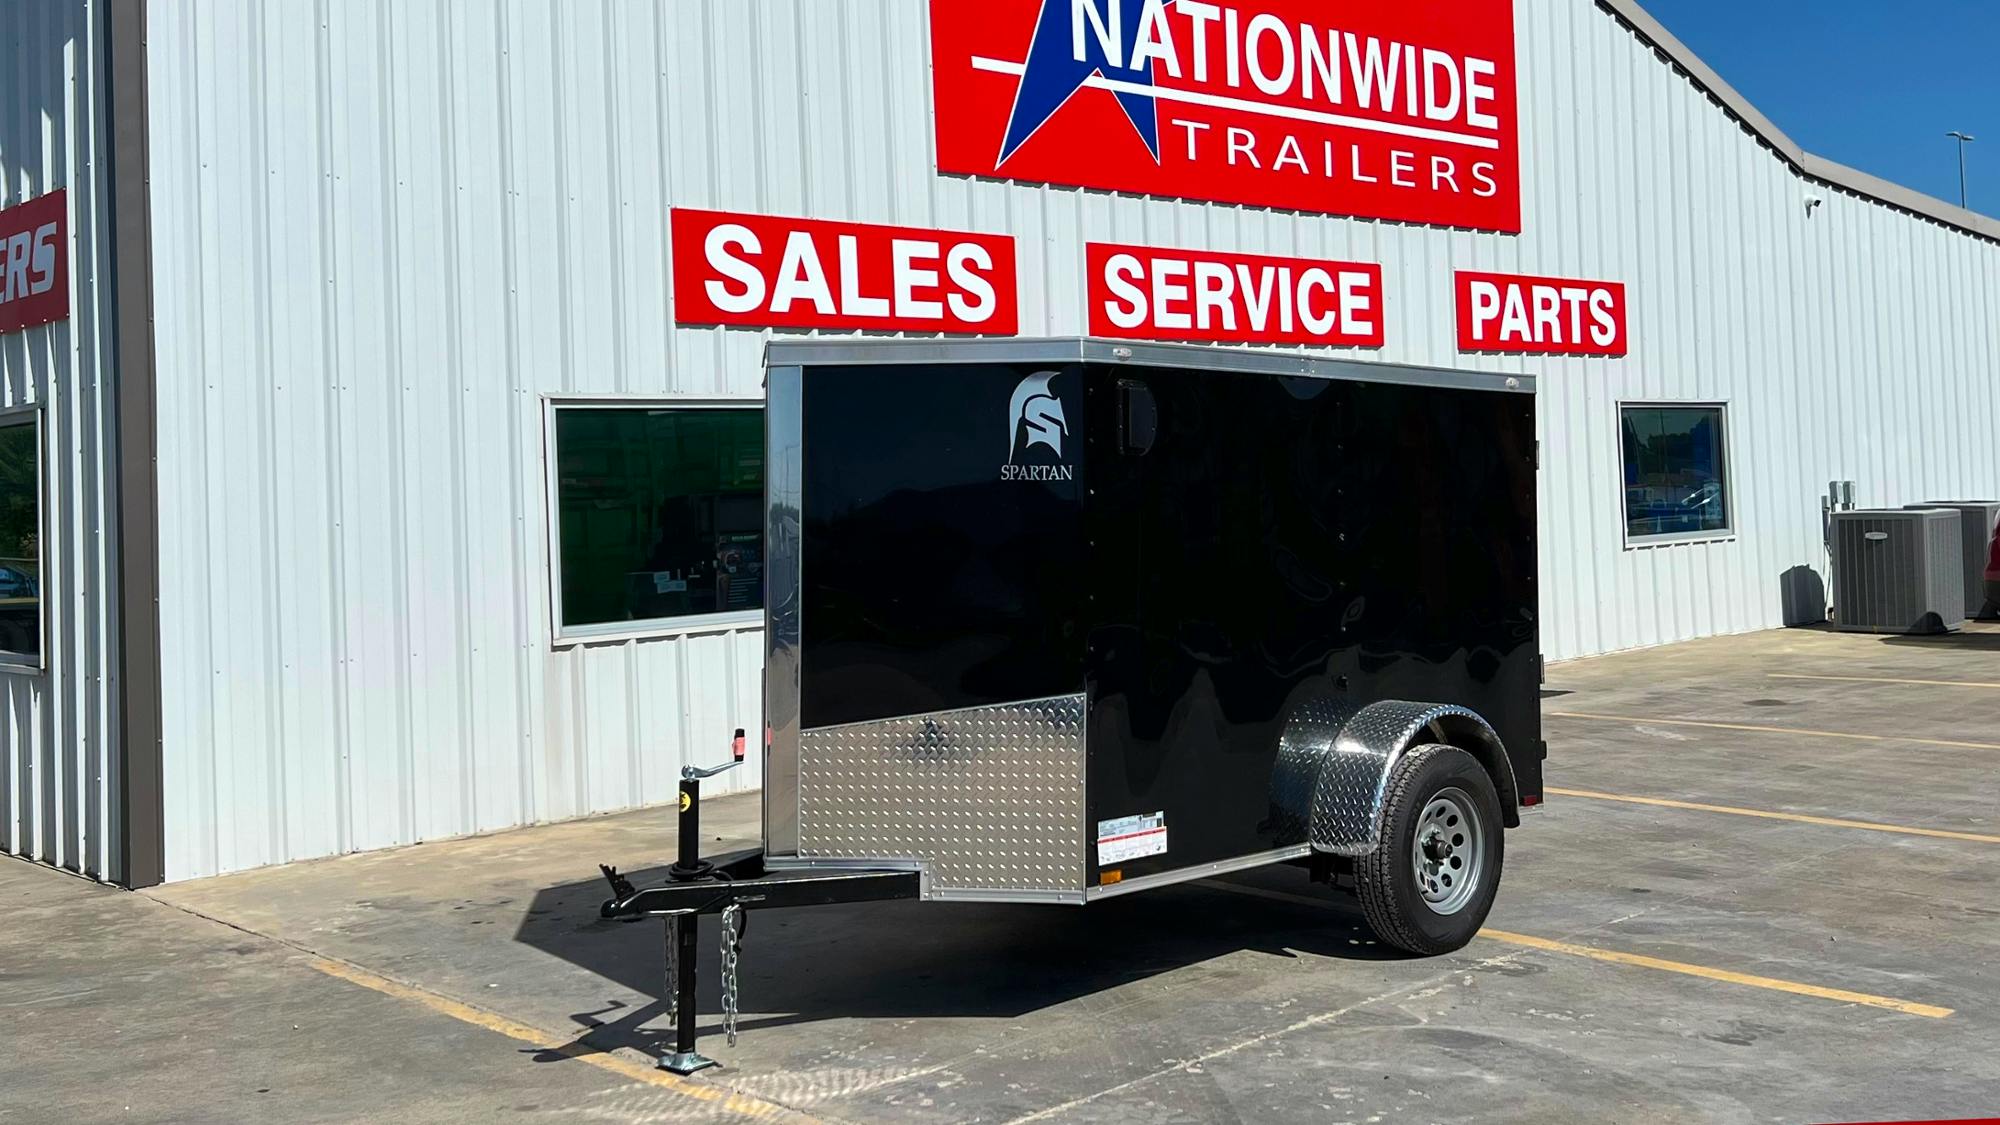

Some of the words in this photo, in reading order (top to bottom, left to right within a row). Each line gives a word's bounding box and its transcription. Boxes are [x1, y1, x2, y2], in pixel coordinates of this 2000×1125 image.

[1071, 0, 1498, 130] NATIONWIDE
[1171, 118, 1498, 197] TRAILERS
[704, 223, 996, 323] SALES
[1104, 253, 1373, 337] SERVICE
[1470, 280, 1617, 348] PARTS
[1000, 464, 1073, 481] SPARTAN
